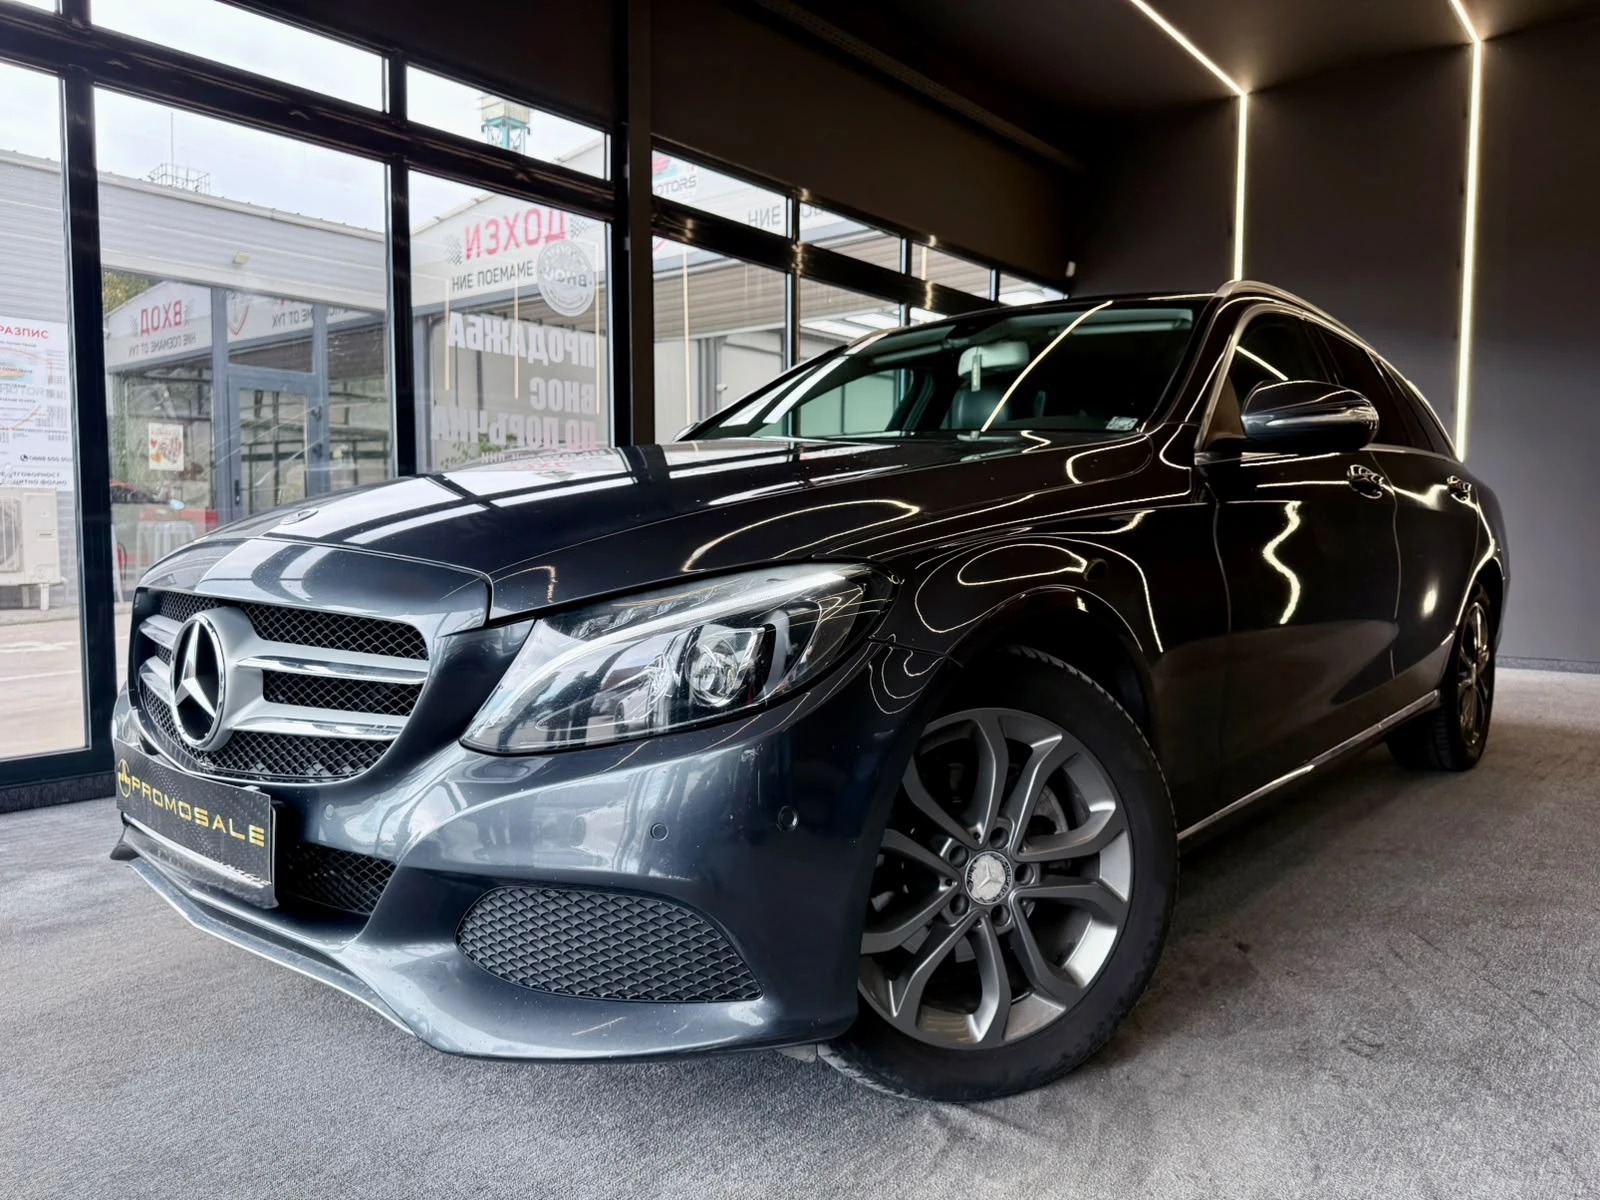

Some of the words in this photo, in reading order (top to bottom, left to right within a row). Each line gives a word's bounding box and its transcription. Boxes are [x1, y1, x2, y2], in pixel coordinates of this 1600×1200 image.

[653, 175, 697, 195] OTORS
[465, 208, 567, 260] ИЗХОД
[452, 275, 473, 292] НИЕ
[477, 260, 534, 287] ПОЕМАМЕ
[131, 775, 265, 848] PROMOSALE
